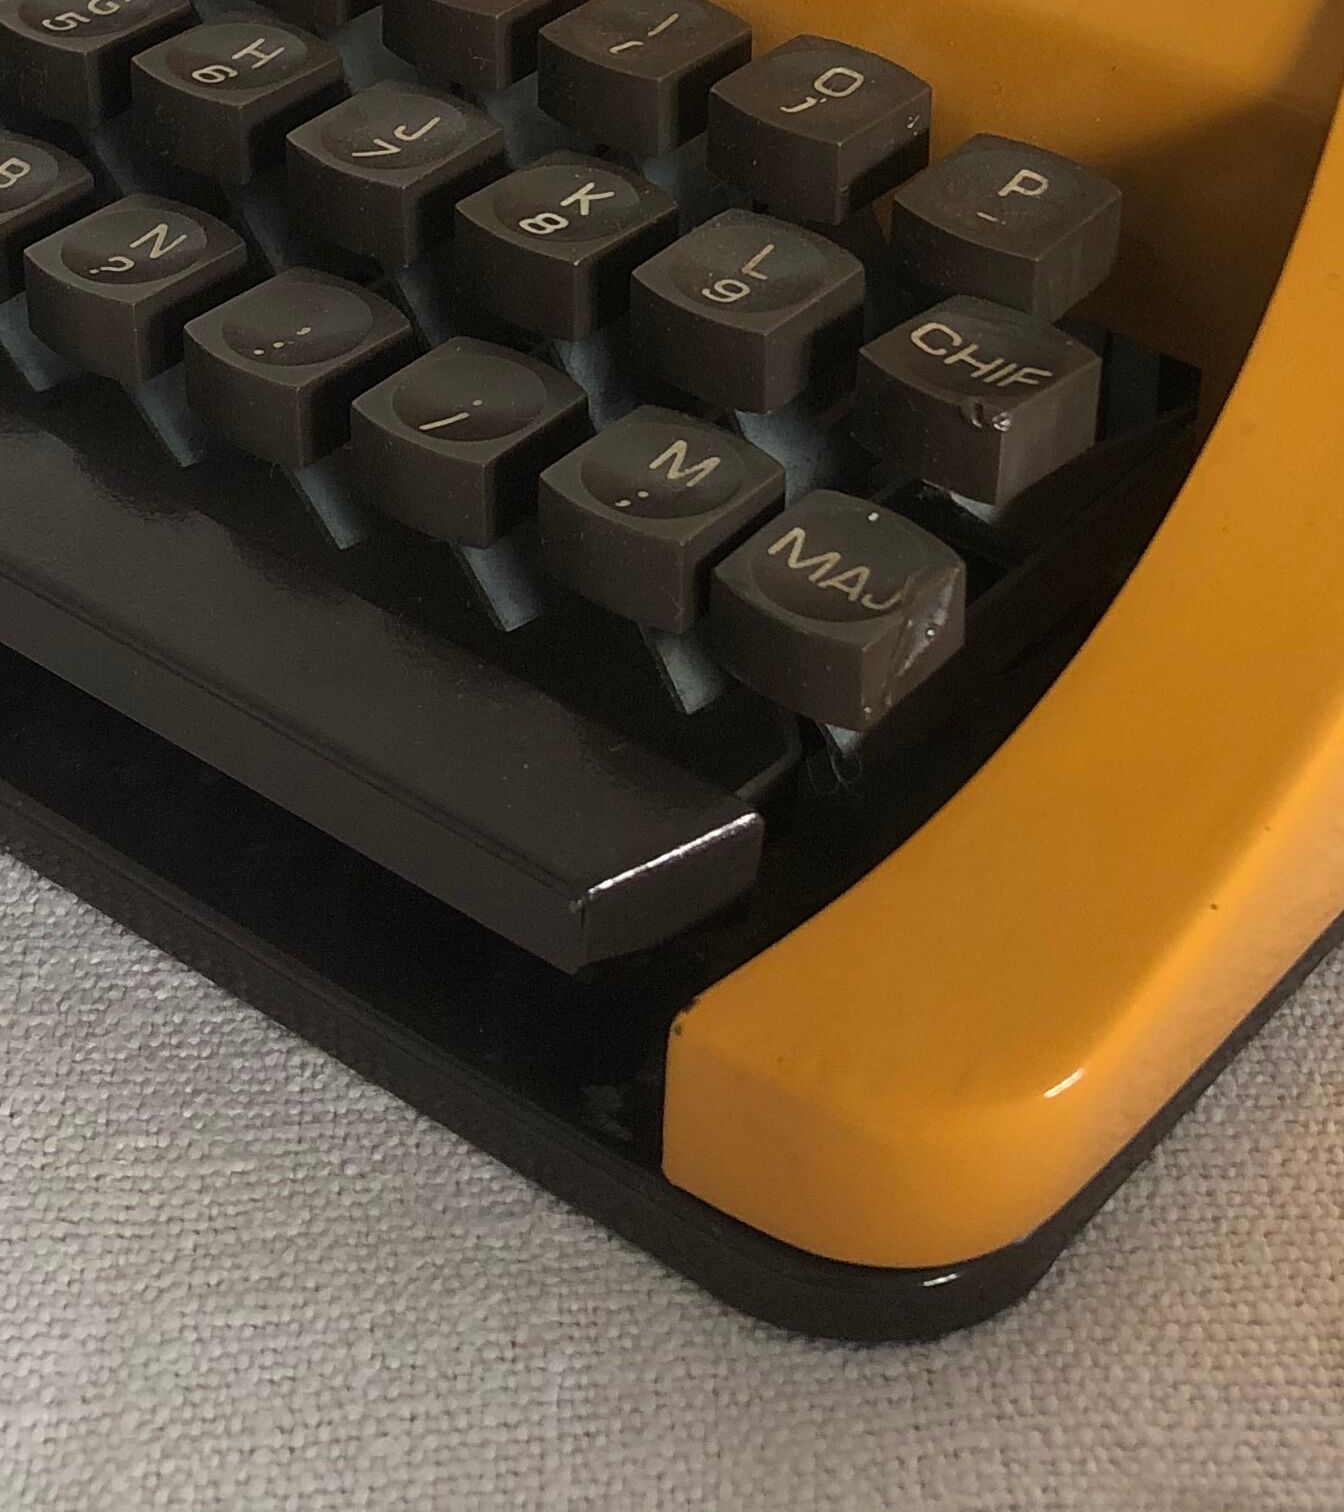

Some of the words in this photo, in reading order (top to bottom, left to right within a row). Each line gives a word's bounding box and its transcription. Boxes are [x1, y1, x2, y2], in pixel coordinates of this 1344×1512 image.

[41, 11, 91, 31] 5
[647, 12, 680, 37] I
[231, 38, 285, 69] H
[191, 64, 238, 84] 6
[813, 66, 865, 98] O
[393, 116, 441, 141] J
[351, 138, 402, 156] 7
[998, 169, 1049, 197] P
[559, 182, 615, 216] K
[518, 211, 569, 235] 8
[129, 222, 188, 260] N
[740, 243, 775, 281] L
[701, 278, 752, 303] 9
[910, 322, 1053, 387] CHIF
[648, 438, 721, 488] M
[767, 526, 902, 610] MAJ
